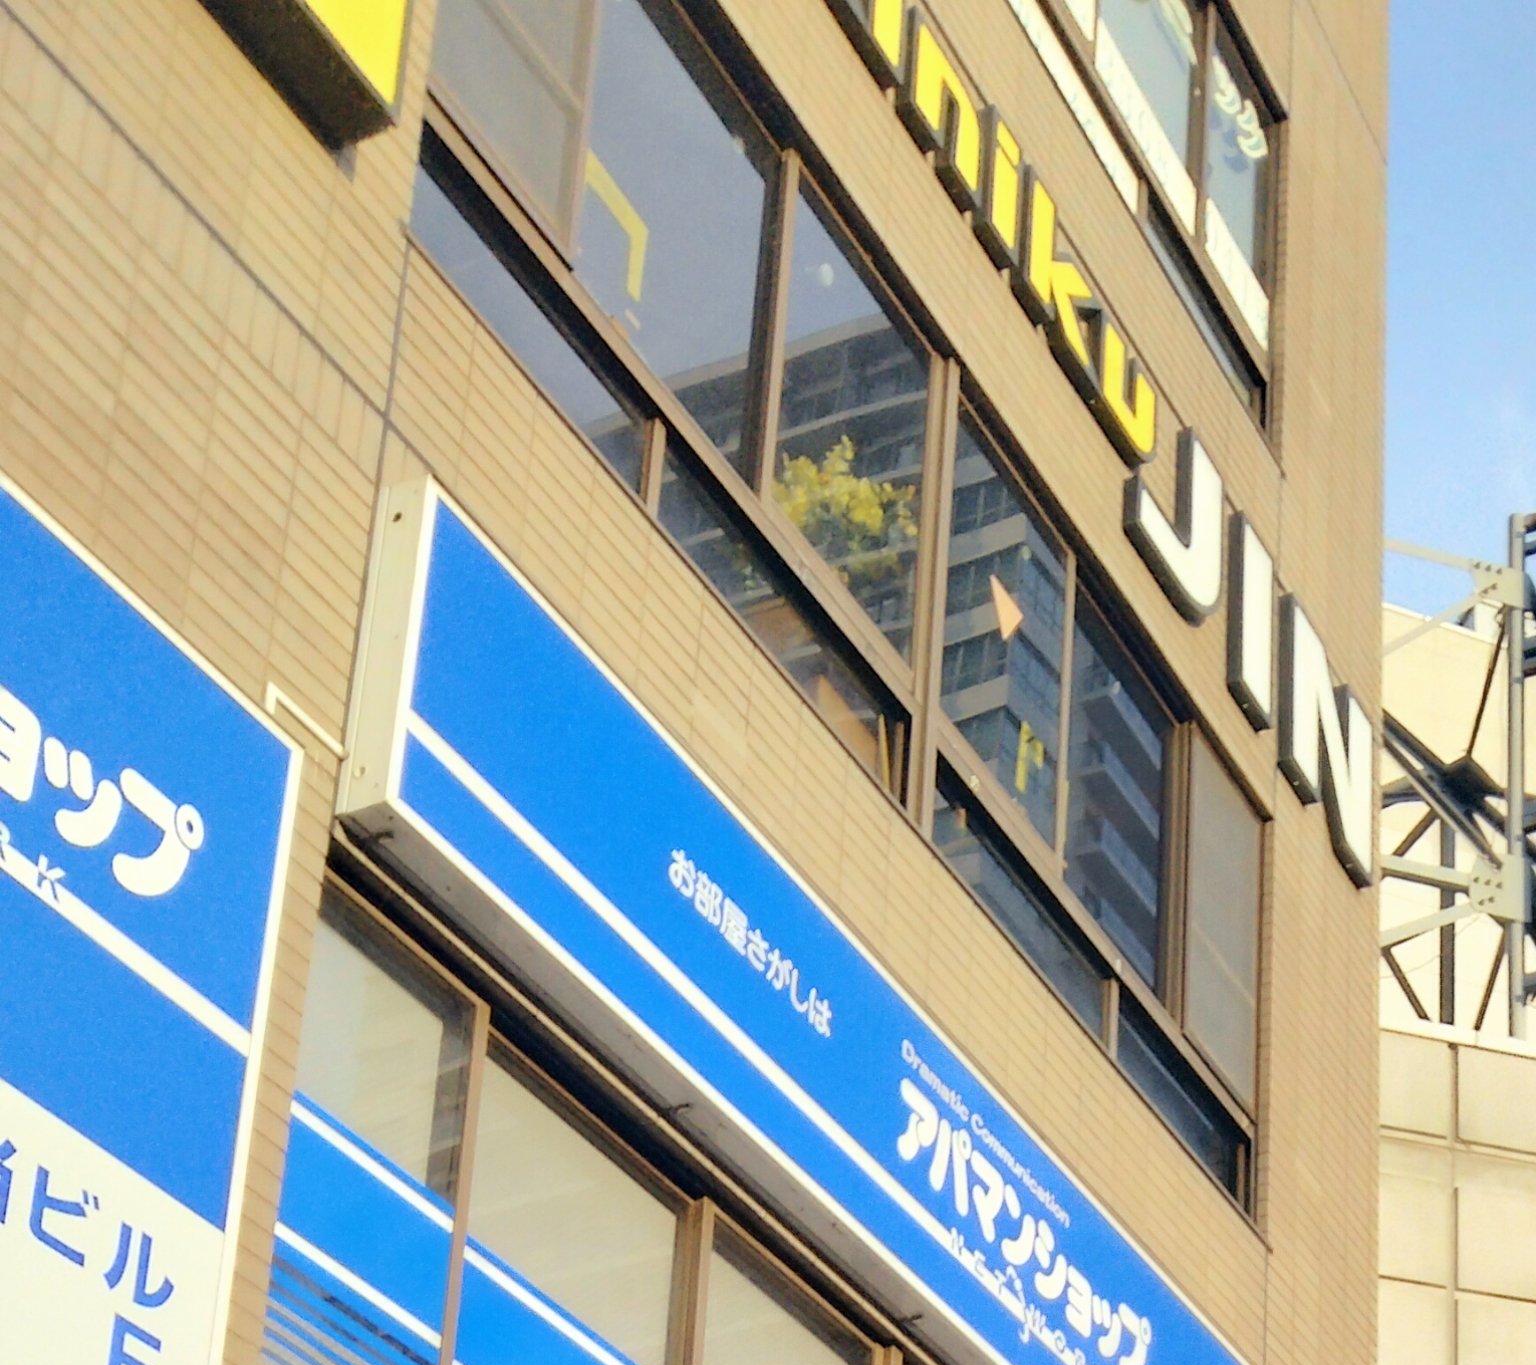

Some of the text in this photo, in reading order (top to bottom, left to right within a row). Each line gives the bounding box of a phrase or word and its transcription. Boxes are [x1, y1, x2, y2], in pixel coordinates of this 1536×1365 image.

[1136, 436, 1373, 877] JIN
[668, 849, 832, 1038] お部屋さがしは
[970, 1113, 1070, 1228] Communication
